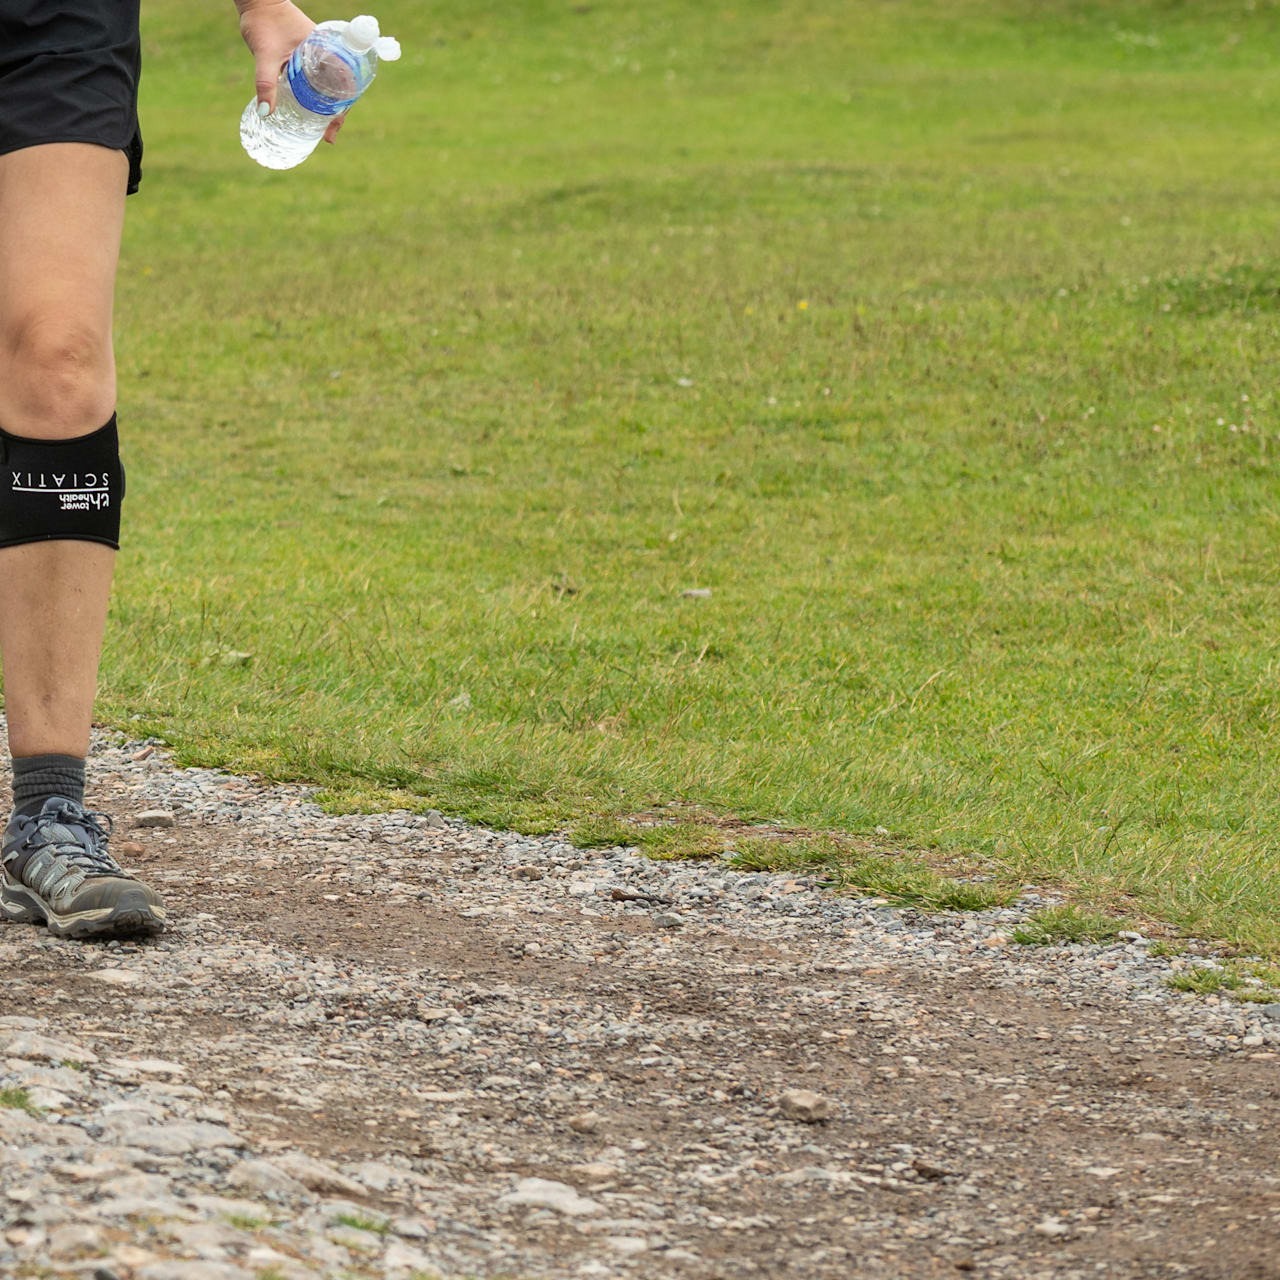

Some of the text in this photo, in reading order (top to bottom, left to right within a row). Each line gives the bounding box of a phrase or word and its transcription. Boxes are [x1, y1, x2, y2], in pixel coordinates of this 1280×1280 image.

[12, 472, 109, 487] SCIATIX
[59, 493, 90, 502] health
[60, 502, 90, 511] tower
